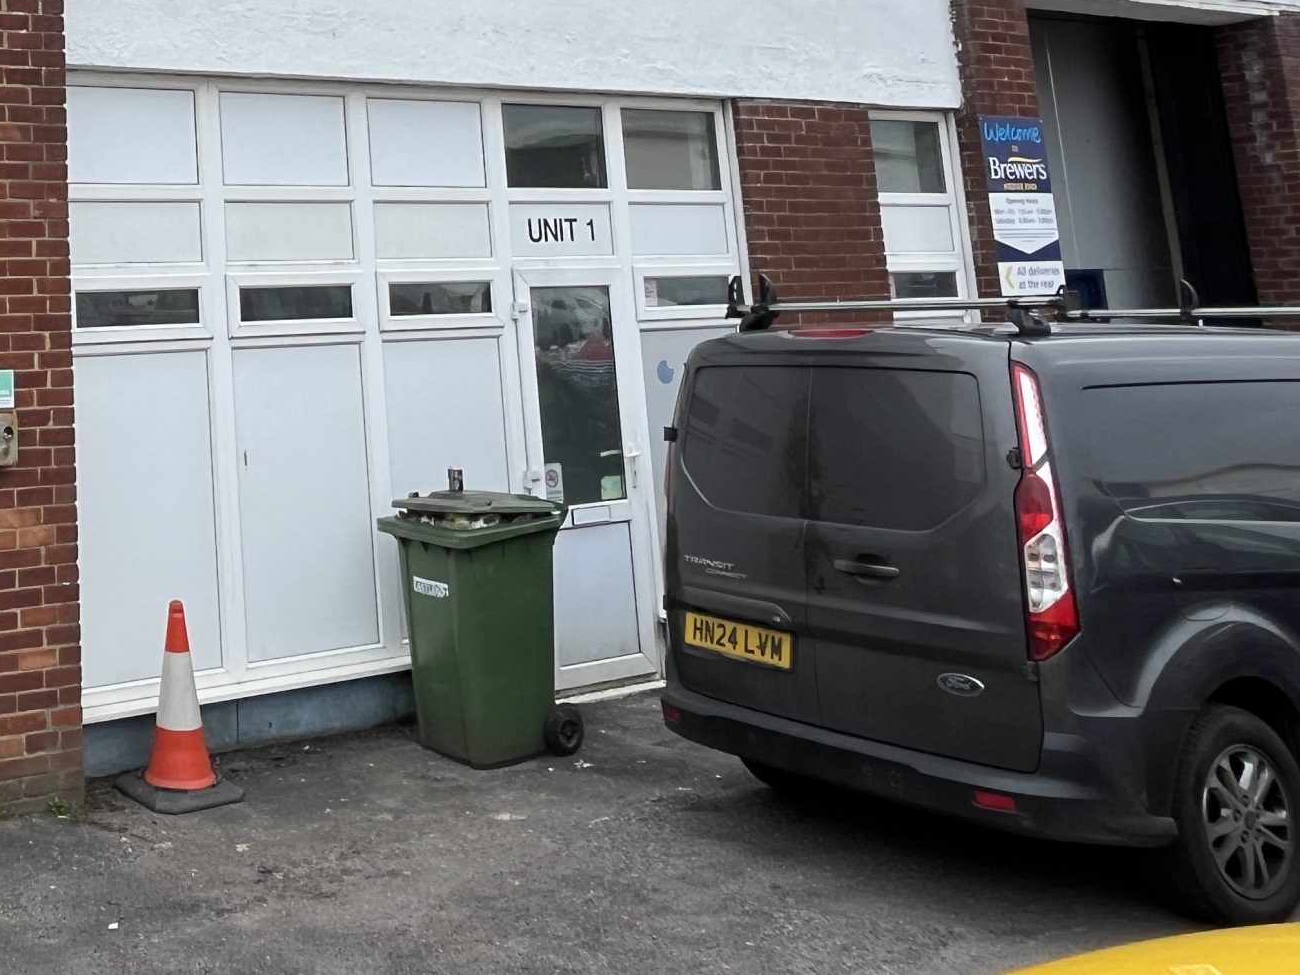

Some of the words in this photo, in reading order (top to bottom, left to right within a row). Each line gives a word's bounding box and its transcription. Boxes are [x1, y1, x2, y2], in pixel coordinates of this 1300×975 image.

[984, 123, 1041, 143] Welcome
[989, 157, 1047, 179] Brewers
[528, 218, 577, 242] UNIT
[586, 219, 595, 242] 1
[684, 554, 735, 570] TRANSIT
[692, 619, 738, 650] HN24
[744, 628, 783, 662] LVM
